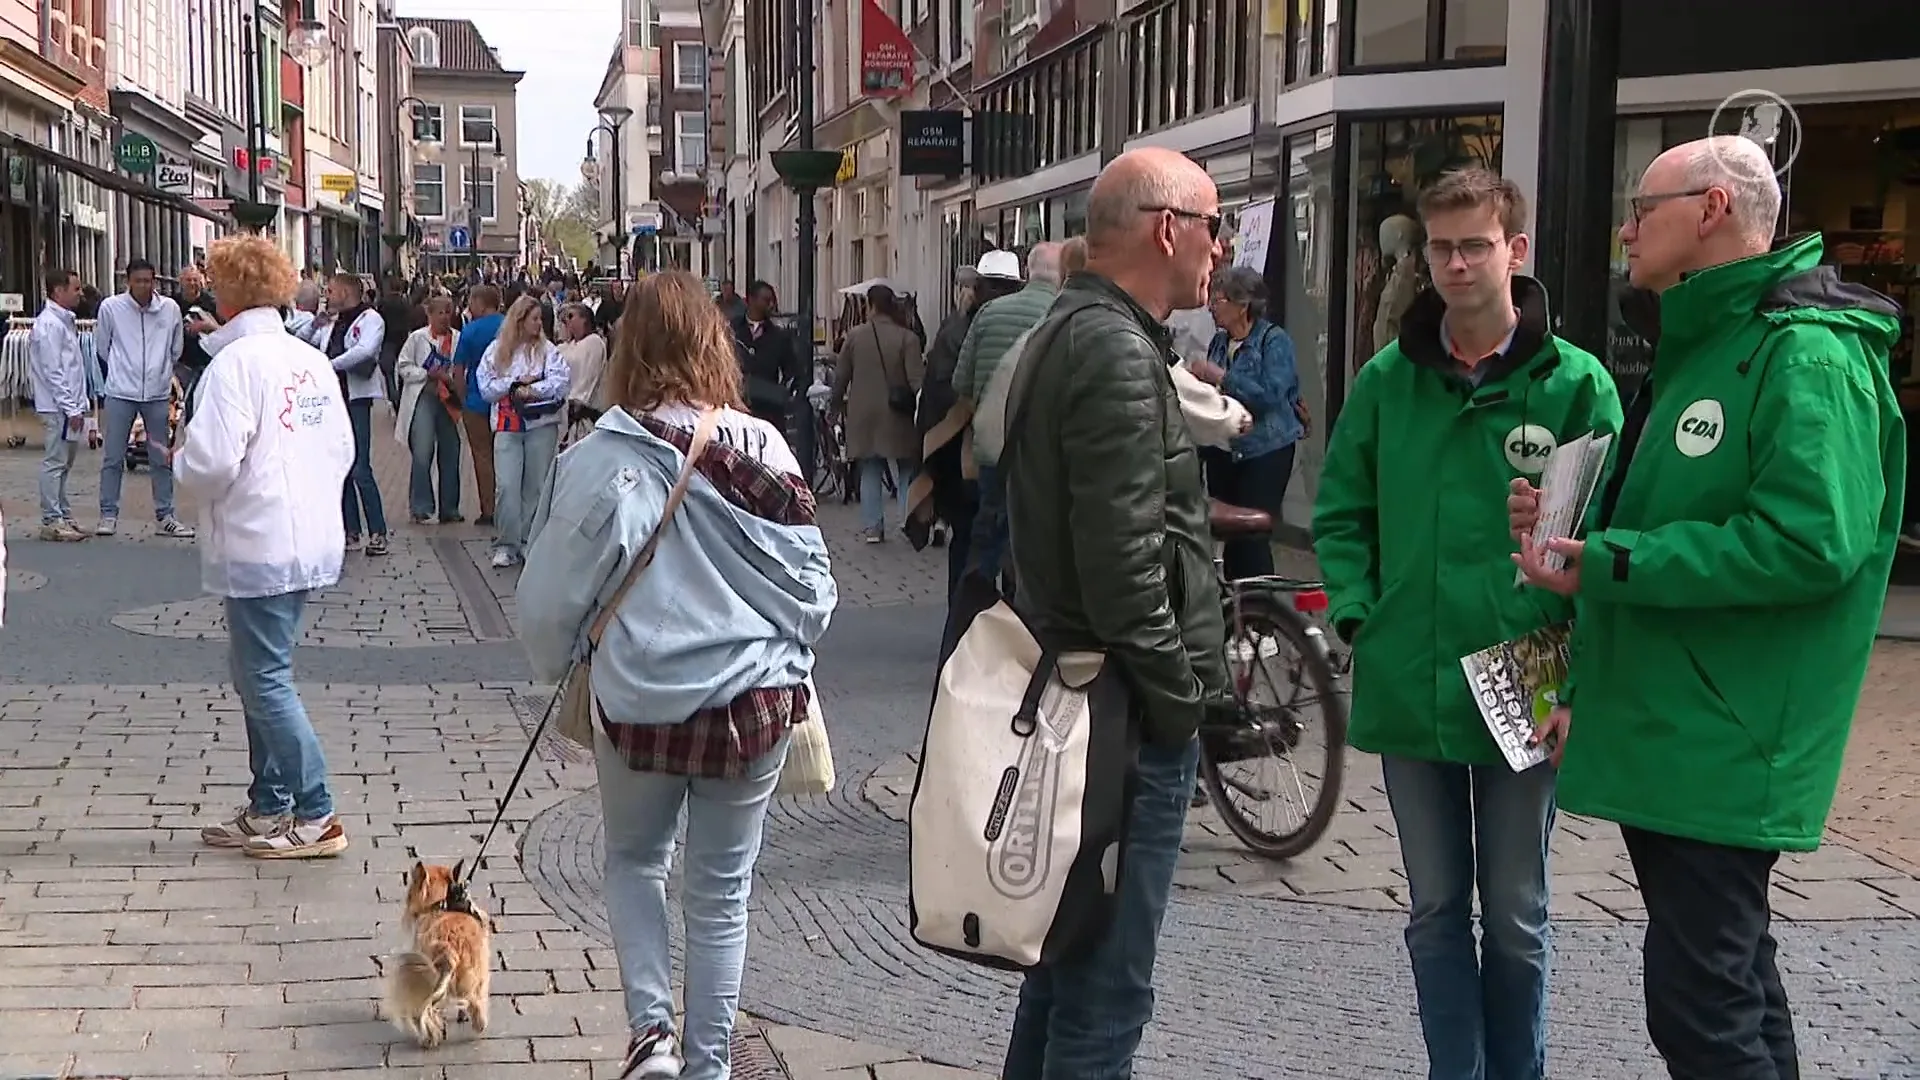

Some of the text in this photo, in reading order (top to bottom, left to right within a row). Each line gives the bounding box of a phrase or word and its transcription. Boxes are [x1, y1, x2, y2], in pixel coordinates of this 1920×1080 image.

[922, 126, 943, 136] GSM
[907, 135, 958, 147] REPARATIE
[1681, 416, 1720, 441] CDA
[1509, 440, 1552, 459] CDA
[1475, 671, 1530, 765] Samen
